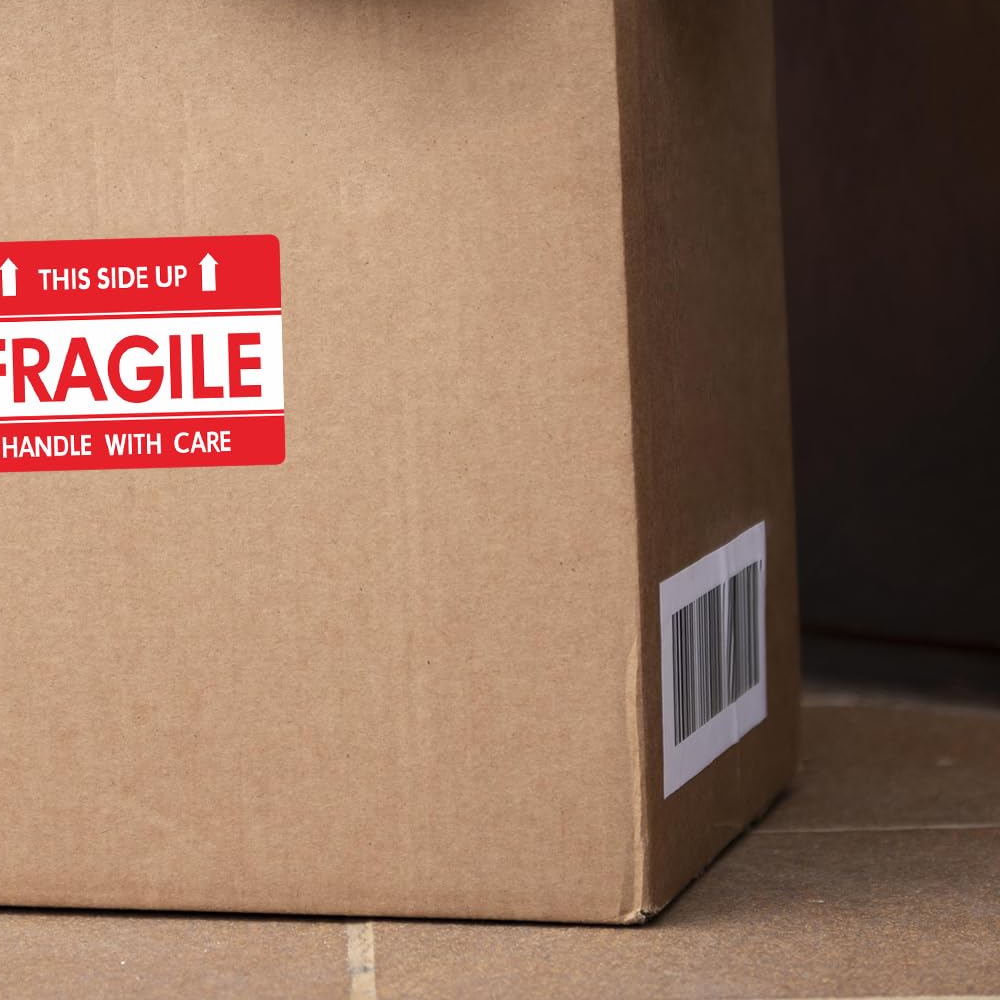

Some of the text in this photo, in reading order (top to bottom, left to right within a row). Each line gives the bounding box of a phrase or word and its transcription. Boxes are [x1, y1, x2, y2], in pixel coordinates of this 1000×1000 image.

[38, 265, 188, 291] THIS SIDE UP
[2, 430, 232, 459] HANDLE WITH CARE
